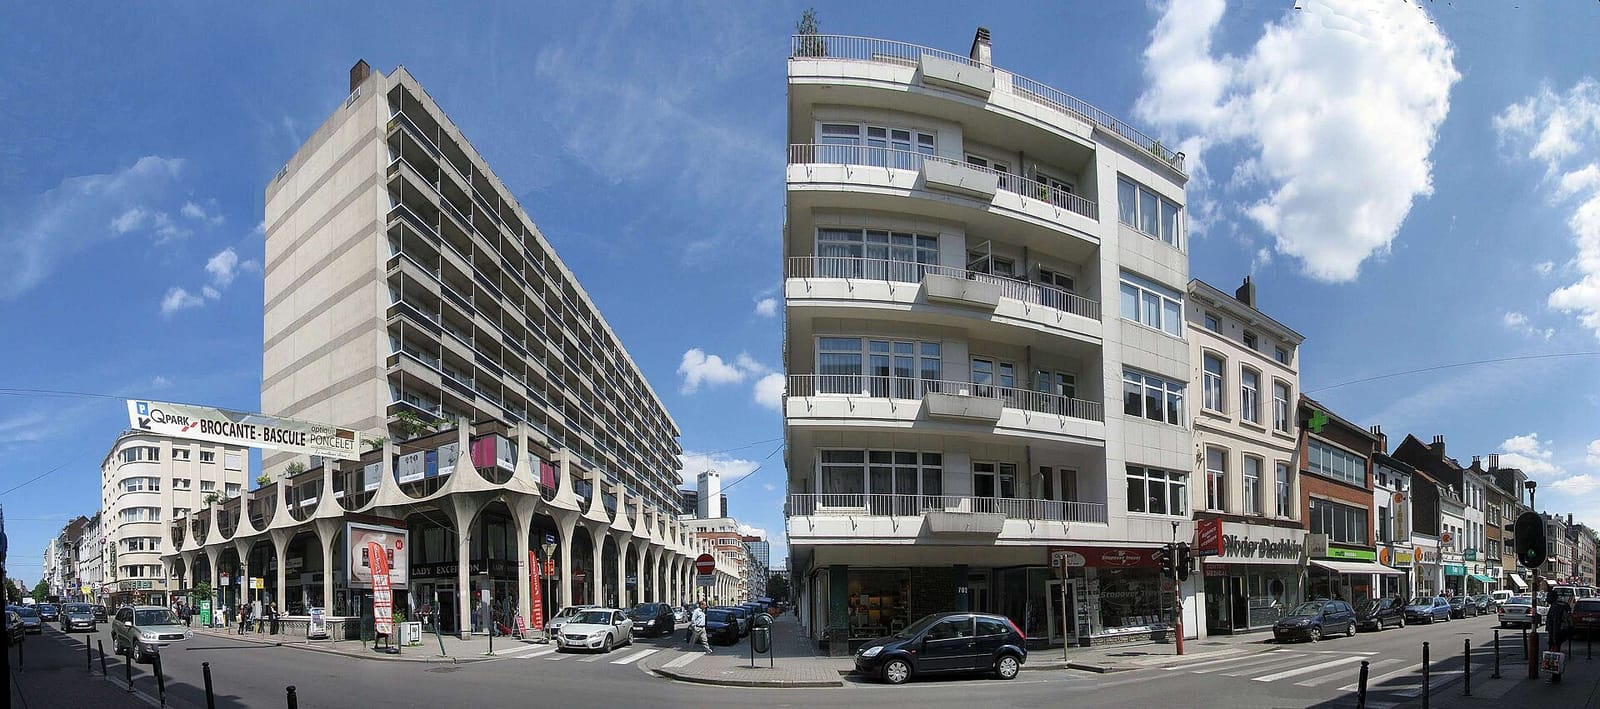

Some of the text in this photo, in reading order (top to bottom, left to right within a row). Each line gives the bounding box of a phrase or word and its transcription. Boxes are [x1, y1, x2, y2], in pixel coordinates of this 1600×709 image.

[200, 419, 256, 440] BROCANTE
[263, 427, 306, 447] BASCULE
[310, 433, 355, 450] PONCELET
[412, 567, 432, 576] LADY
